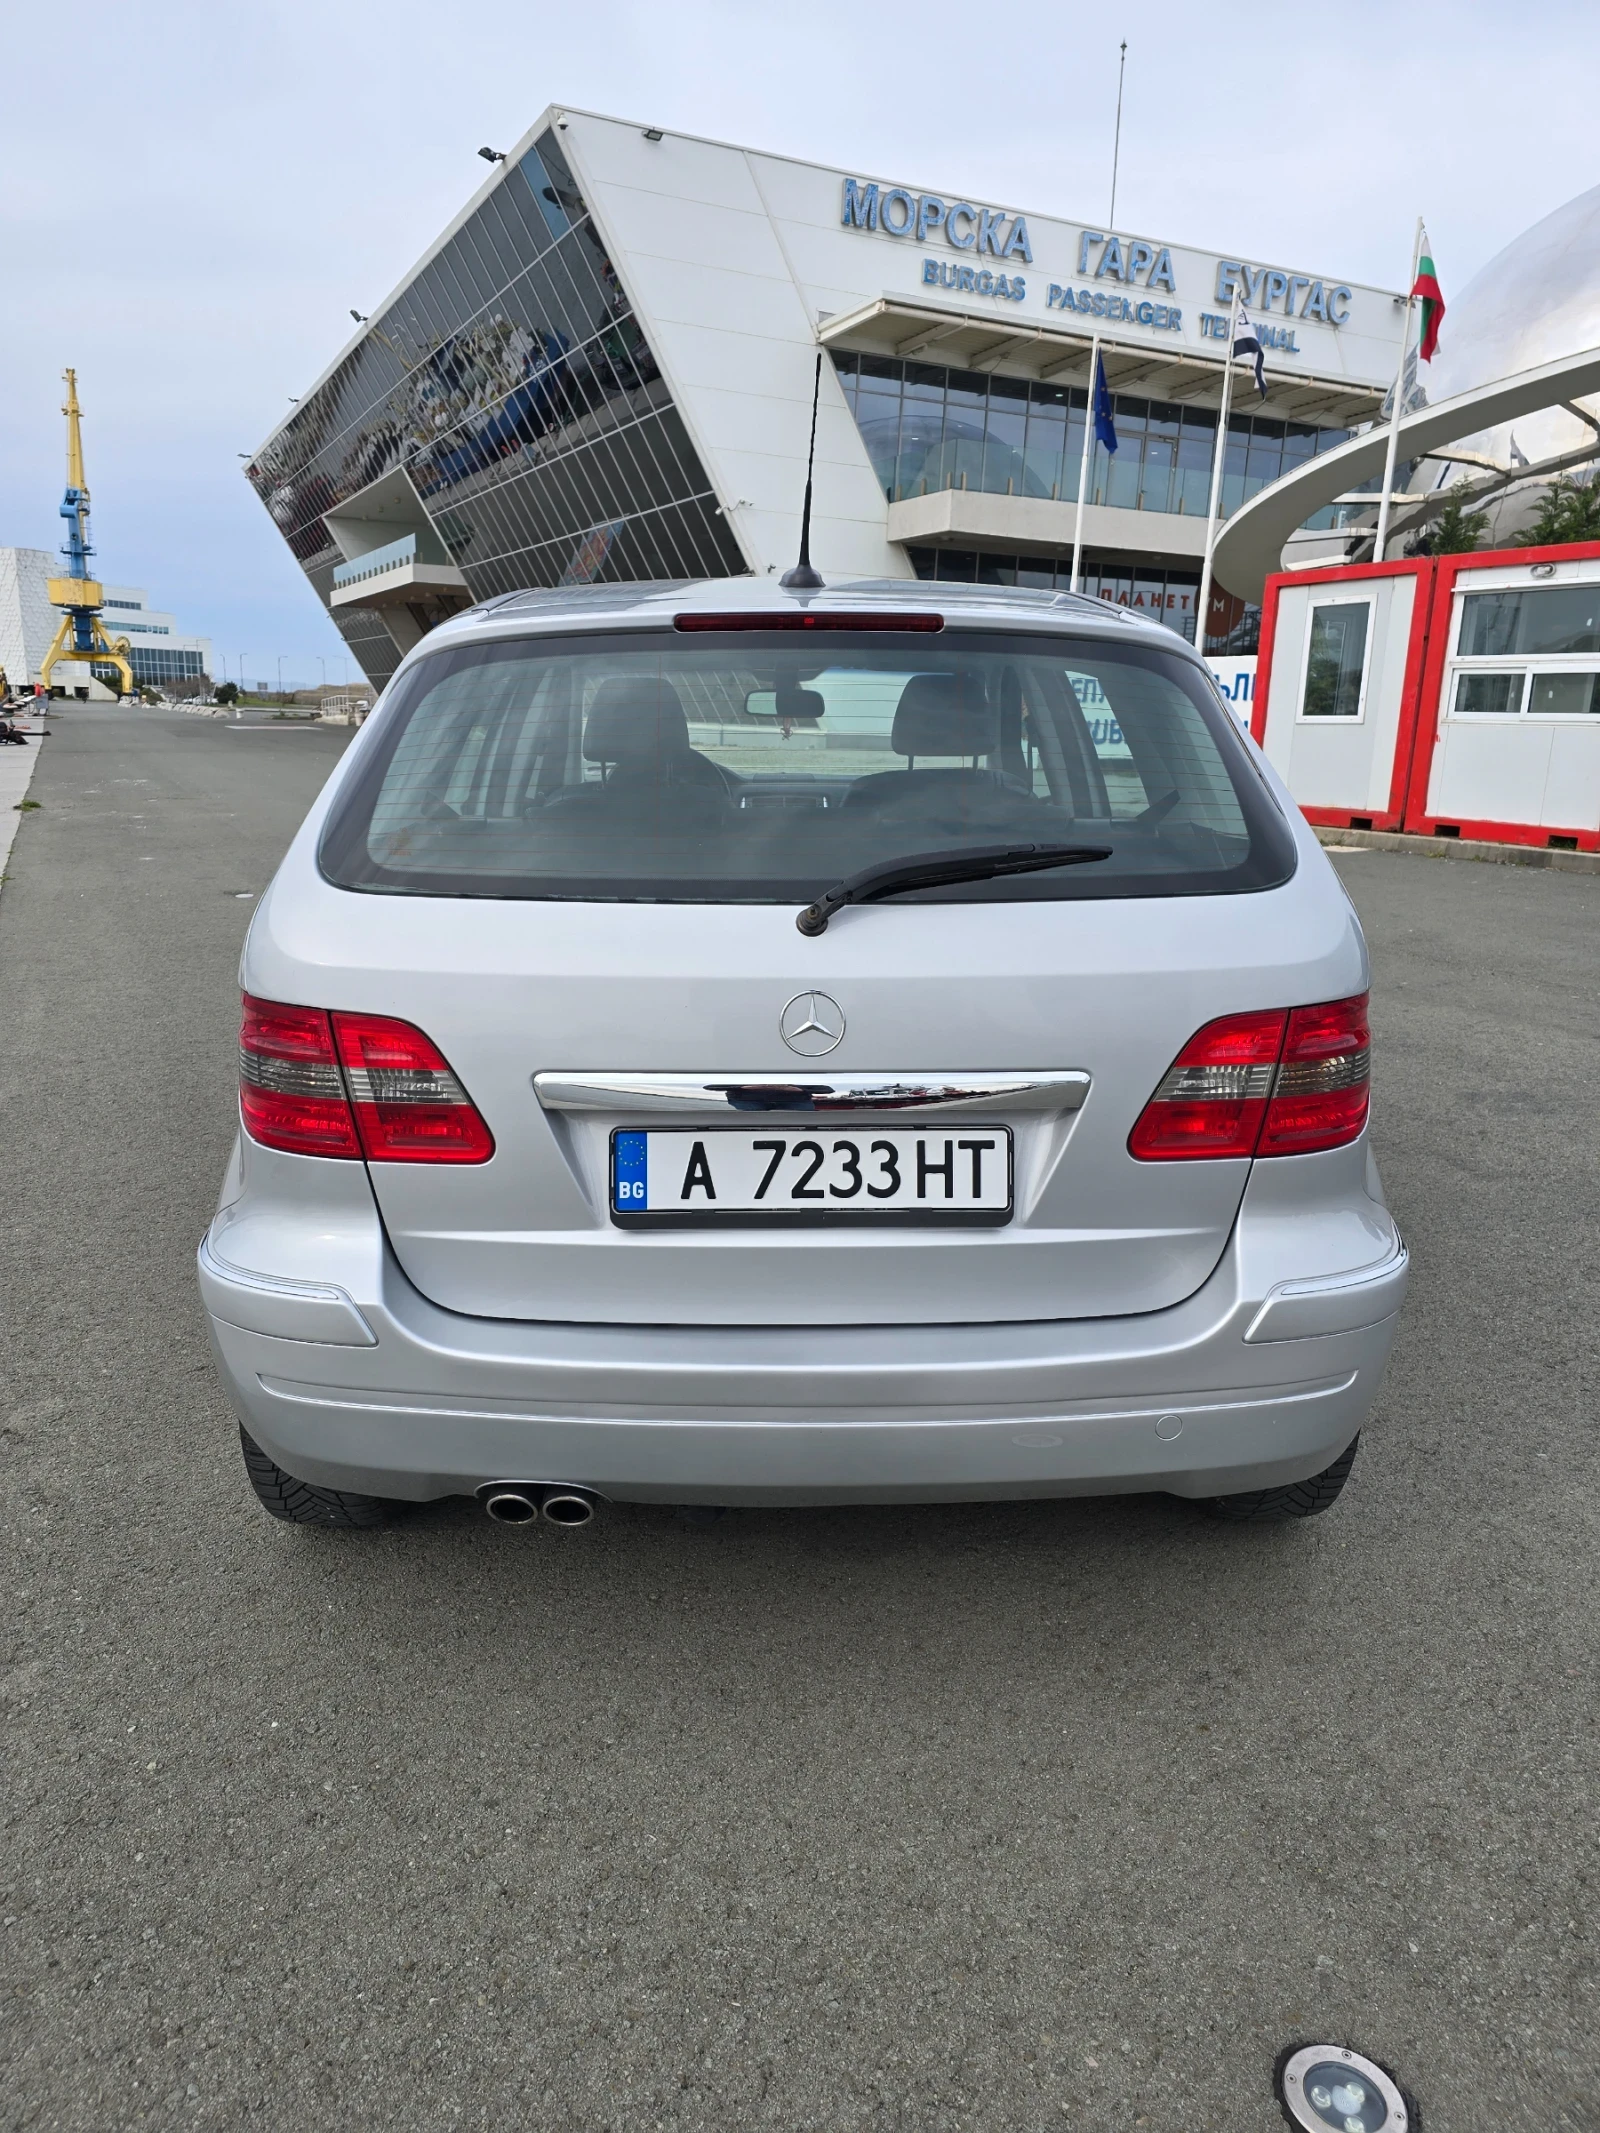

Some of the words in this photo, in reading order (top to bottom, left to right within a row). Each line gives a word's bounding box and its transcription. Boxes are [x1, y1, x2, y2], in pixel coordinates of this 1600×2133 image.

[842, 178, 1033, 263] МОРСКА
[1077, 231, 1176, 292] ГАРА
[1215, 260, 1352, 325] БУРГАС
[922, 258, 1026, 301] BURGAS
[1047, 283, 1182, 331] PASSENGER
[1101, 588, 1190, 610] ПЛАНЕТ
[619, 1181, 645, 1199] BG
[681, 1141, 717, 1199] A
